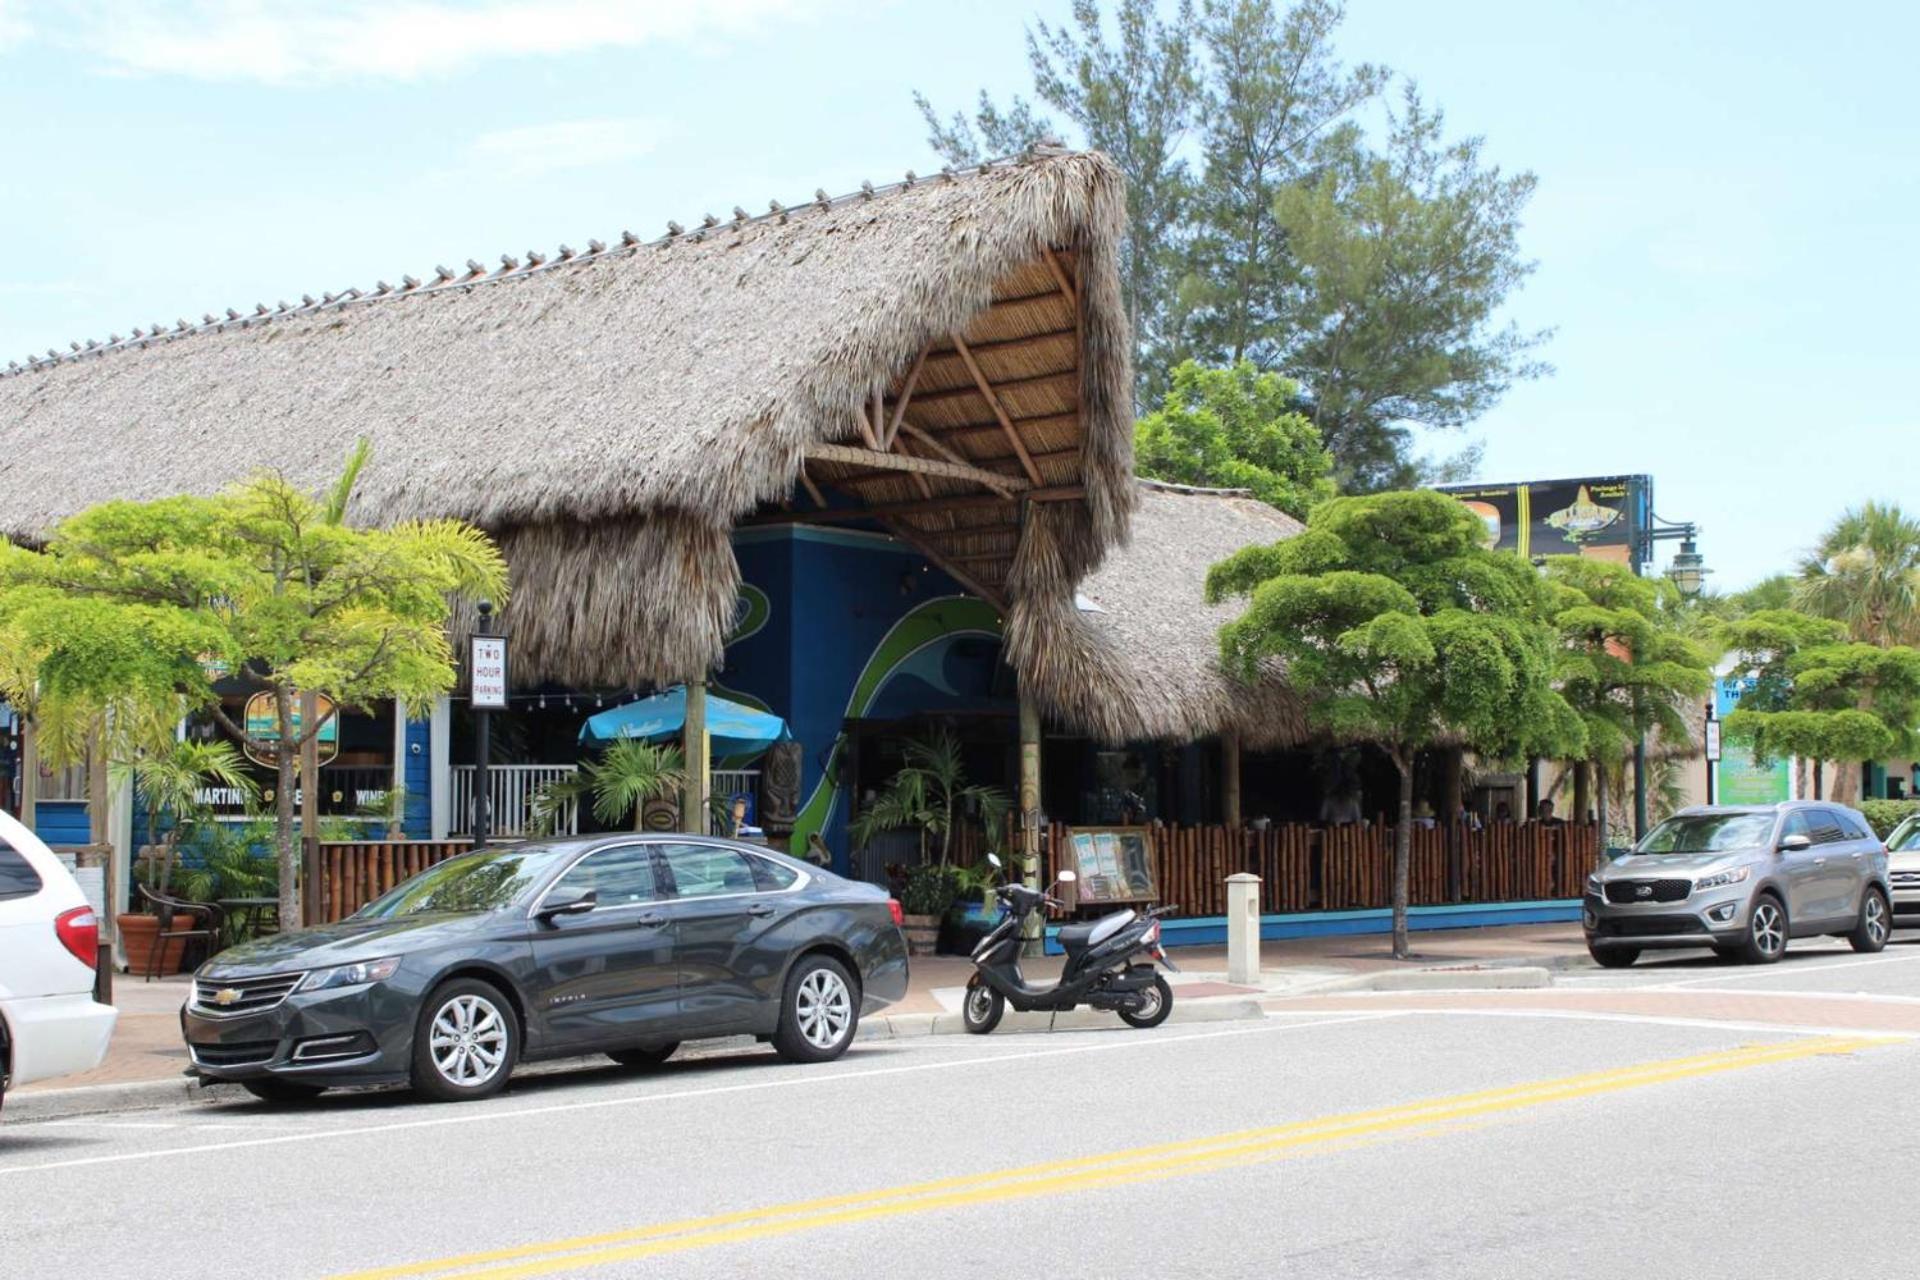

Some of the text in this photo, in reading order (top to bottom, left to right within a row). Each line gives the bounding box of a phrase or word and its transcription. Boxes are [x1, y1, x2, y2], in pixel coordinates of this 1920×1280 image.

[477, 648, 500, 660] TWO
[476, 666, 501, 678] HOUR
[474, 685, 502, 695] PARKING
